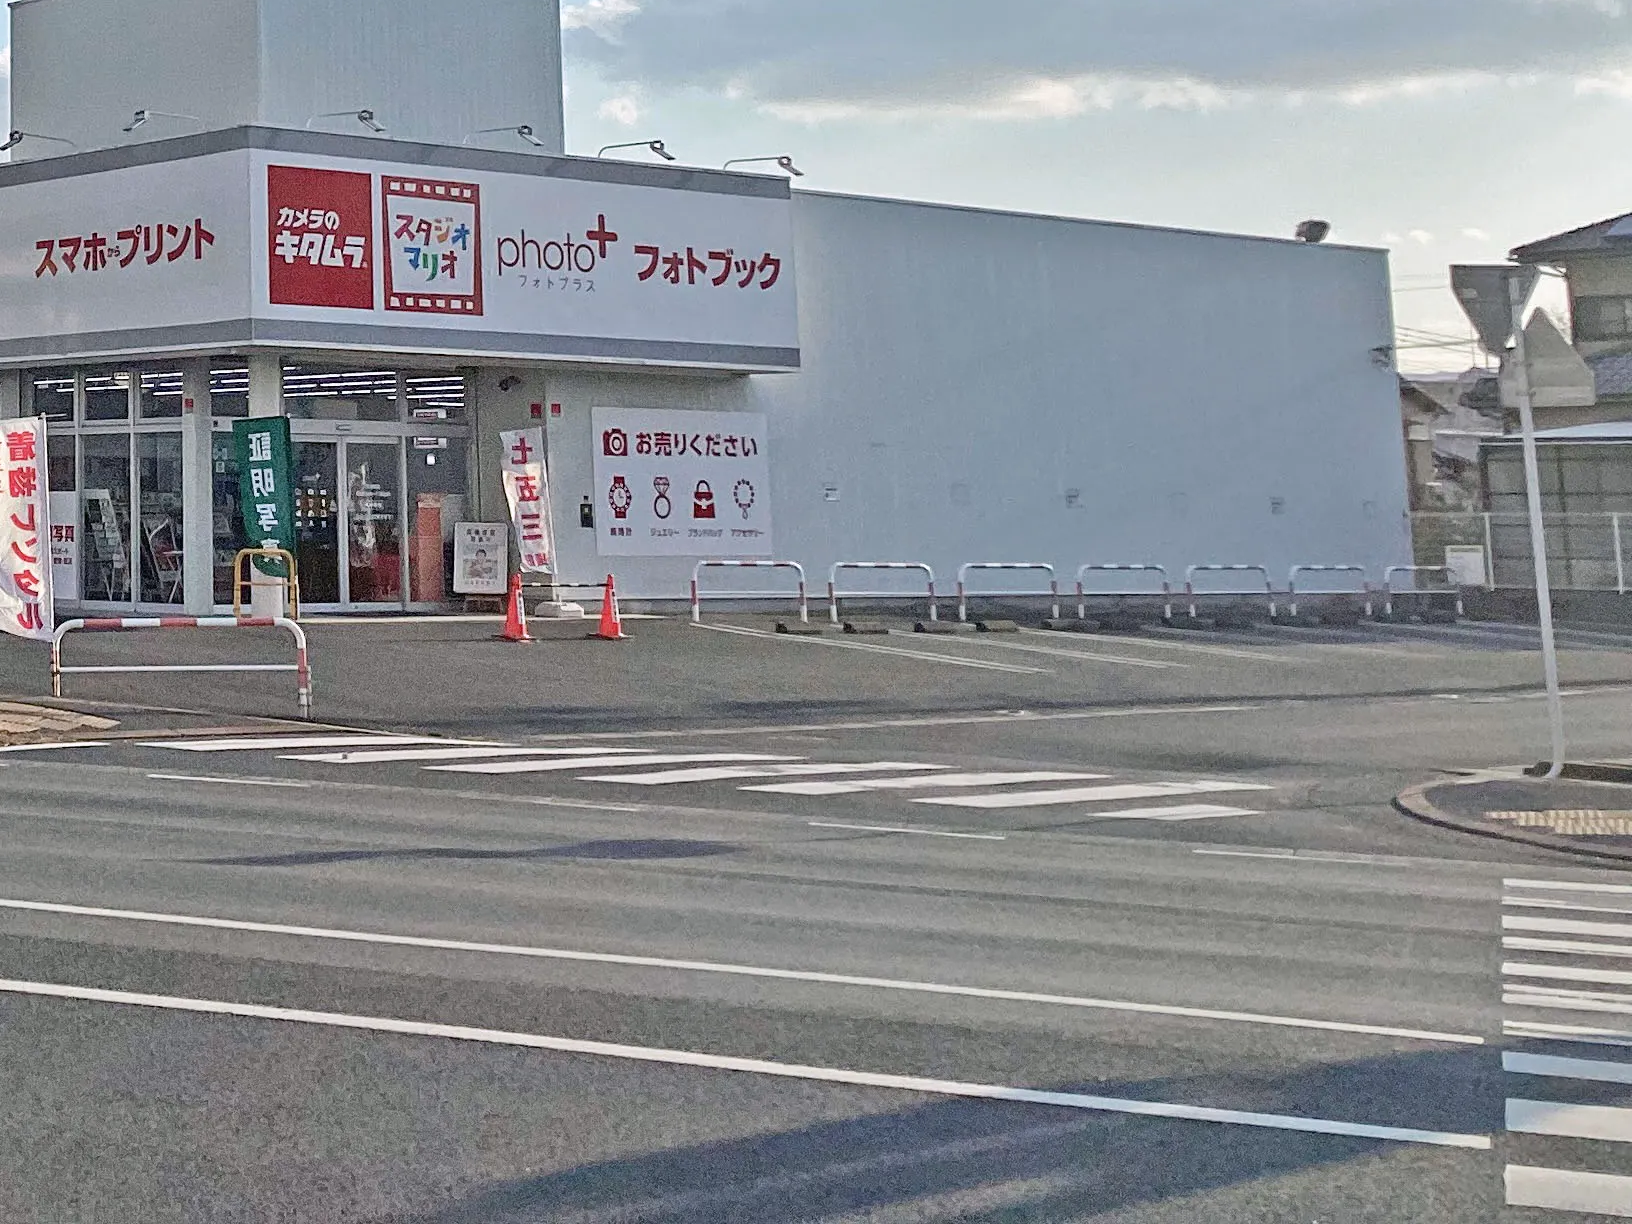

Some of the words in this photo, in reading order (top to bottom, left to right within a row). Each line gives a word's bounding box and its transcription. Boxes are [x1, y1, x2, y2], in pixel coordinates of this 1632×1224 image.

[276, 206, 340, 231] カメラの
[393, 214, 470, 250] スタジオ
[274, 231, 366, 269] キタムラ
[403, 247, 458, 281] マリオ
[633, 244, 781, 290] フォトブック
[518, 274, 596, 292] フォトプラス
[636, 431, 758, 457] お売りください
[50, 525, 74, 542] 写真
